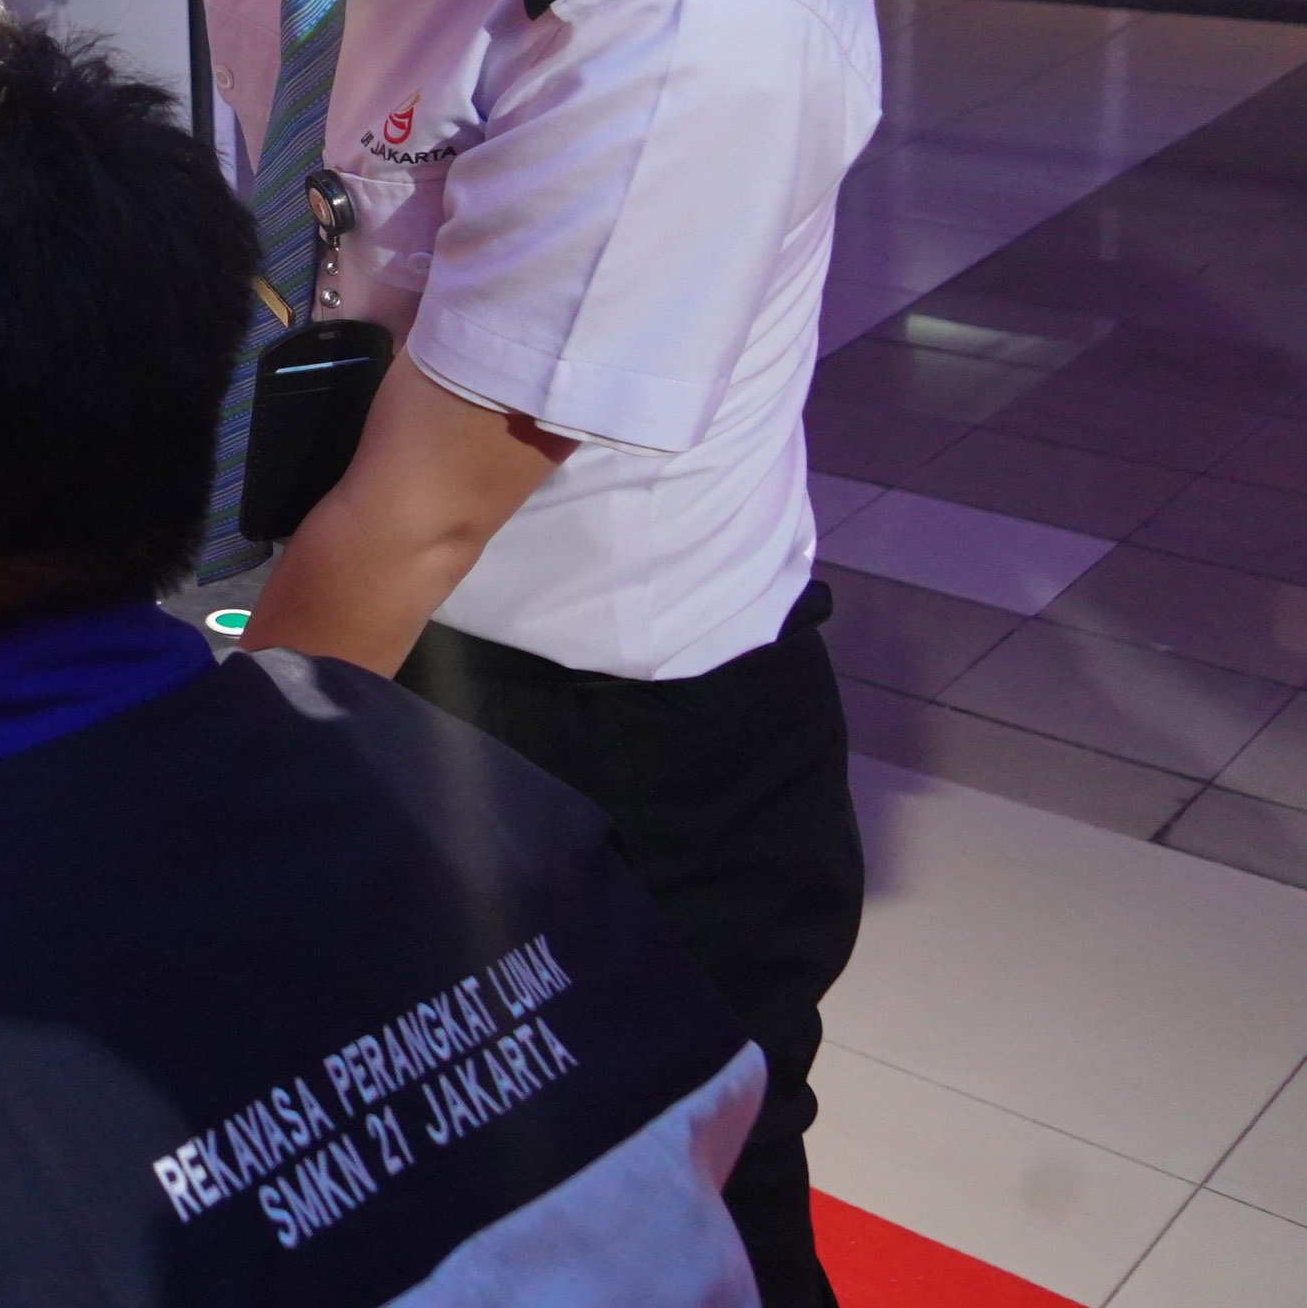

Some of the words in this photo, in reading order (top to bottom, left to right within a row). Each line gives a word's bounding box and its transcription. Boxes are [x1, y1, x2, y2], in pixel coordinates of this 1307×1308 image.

[371, 141, 457, 164] JAKARTA
[153, 1076, 335, 1223] REKAYASA
[322, 976, 497, 1118] PERANGKAT
[487, 933, 572, 1019] LUNAK
[258, 1133, 379, 1249] SMKN
[365, 1105, 414, 1176] 21
[423, 1016, 579, 1146] JAKARTA
